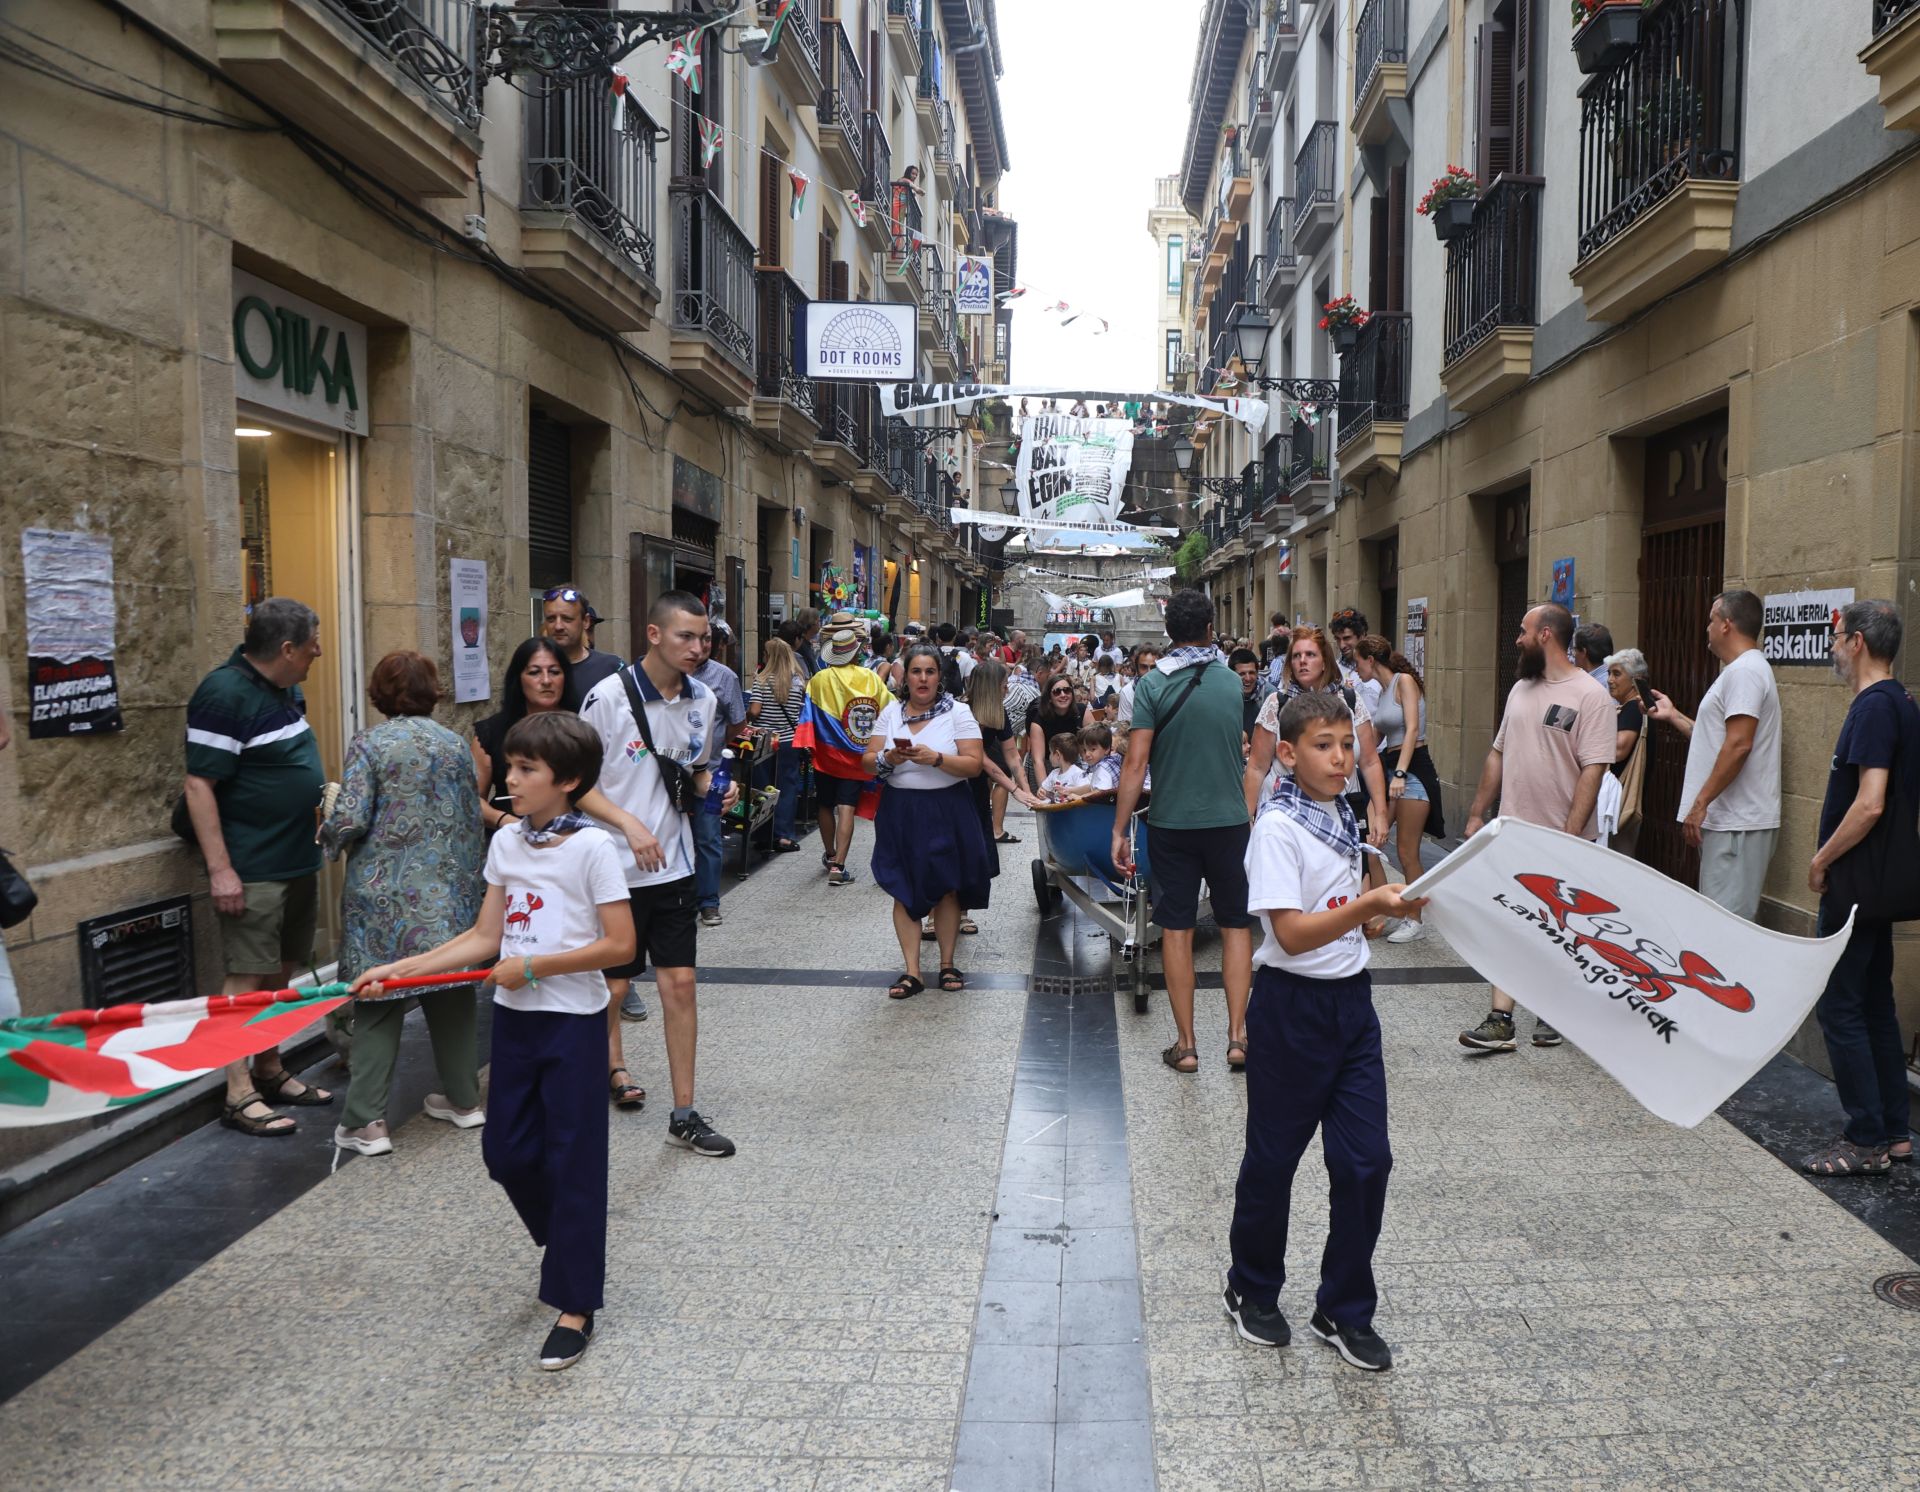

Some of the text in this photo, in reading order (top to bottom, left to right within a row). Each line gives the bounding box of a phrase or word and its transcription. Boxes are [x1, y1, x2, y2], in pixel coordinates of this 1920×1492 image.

[961, 285, 987, 297] alde
[820, 350, 902, 366] DOT ROOMS
[1031, 444, 1072, 471] BAT
[1028, 468, 1075, 510] EGIN
[1765, 603, 1830, 624] EUSKAL HERRIA
[1764, 625, 1830, 660] askatu!
[32, 703, 51, 721] EZ
[50, 701, 70, 718] DA
[1493, 893, 1679, 1044] karmengo jaiak
